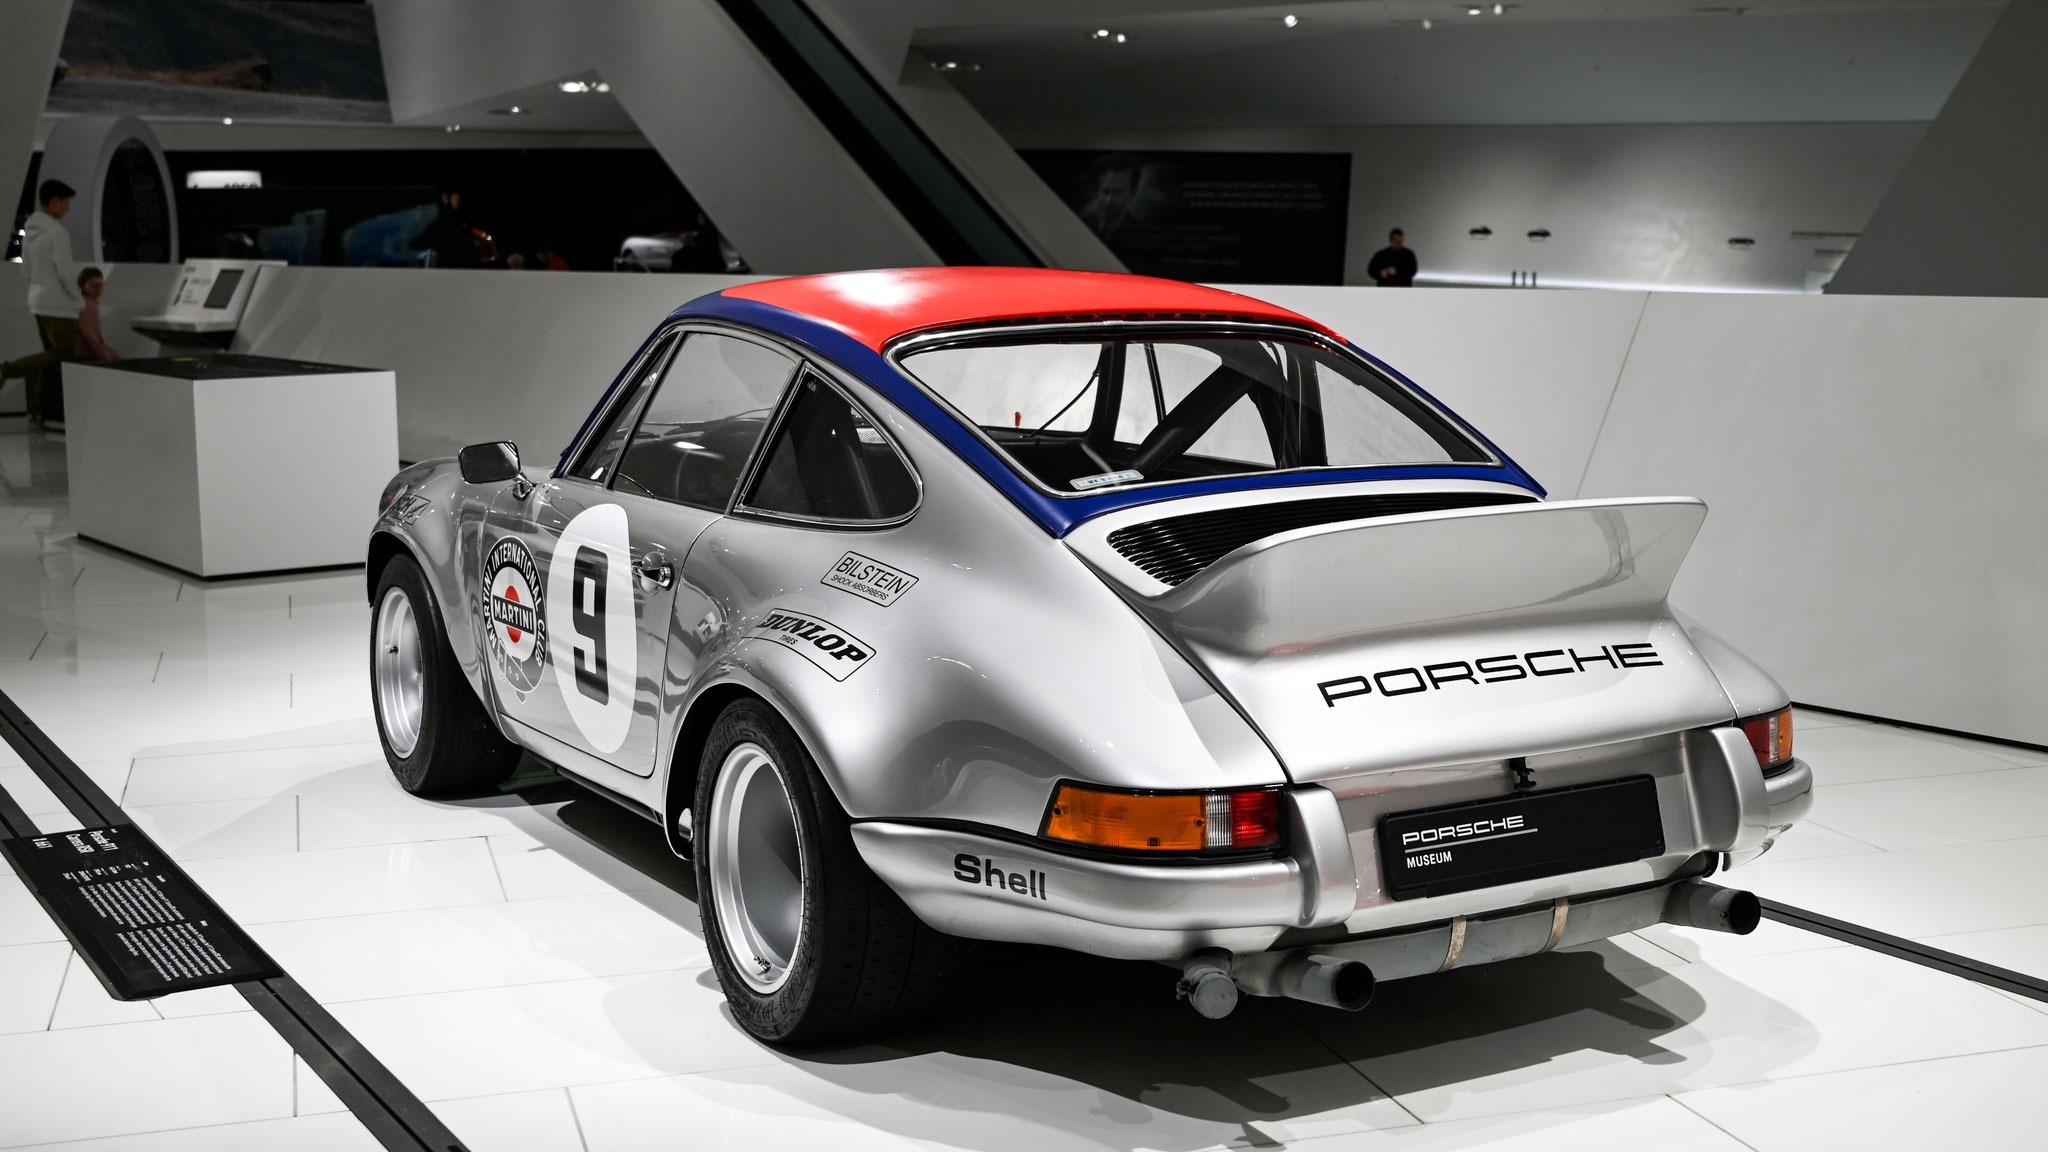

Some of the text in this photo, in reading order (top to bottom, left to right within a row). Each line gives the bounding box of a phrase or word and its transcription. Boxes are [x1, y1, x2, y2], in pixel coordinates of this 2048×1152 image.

[831, 574, 890, 601] SHOCK ABSORBERS
[836, 556, 910, 594] BILSTEIN
[483, 542, 546, 668] MARTINI INTERNATIONAL CLUB
[494, 600, 533, 631] MARTINI
[572, 544, 610, 707] 9
[756, 613, 868, 661] DUNLOP
[778, 634, 799, 646] TIRES
[1317, 642, 1664, 708] PORSCHE
[1402, 815, 1525, 846] PORSCHE
[953, 853, 1047, 901] Shell
[1406, 850, 1453, 869] MUSEUM
